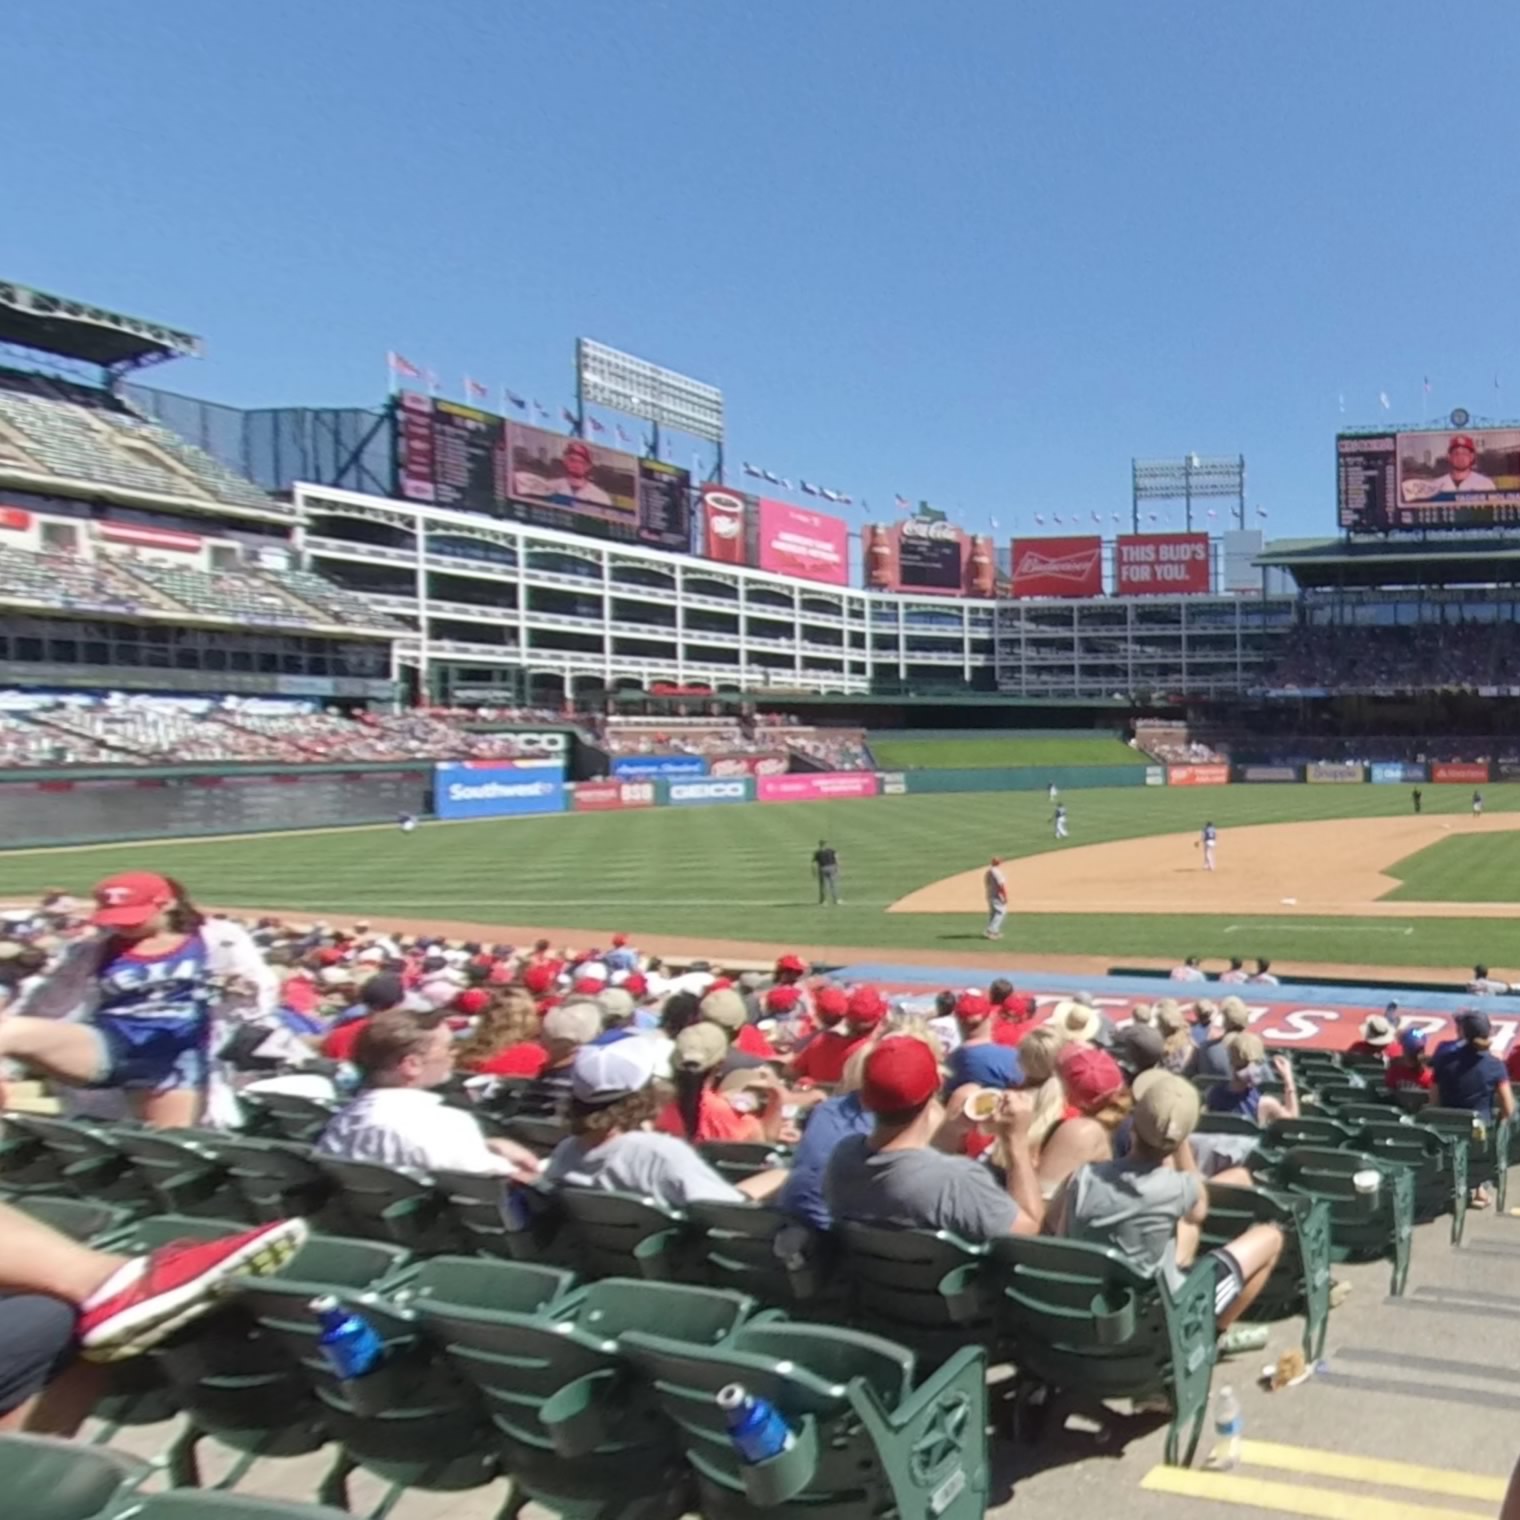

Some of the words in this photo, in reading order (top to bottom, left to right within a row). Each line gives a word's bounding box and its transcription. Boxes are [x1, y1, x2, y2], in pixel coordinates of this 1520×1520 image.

[1121, 545, 1154, 562] THIS
[1159, 543, 1206, 561] BUD'S
[1022, 557, 1092, 574] Budweiser
[1121, 565, 1151, 581] FOR
[1153, 564, 1191, 580] YOU.
[449, 782, 542, 800] Southwest
[670, 782, 745, 799] GEICO
